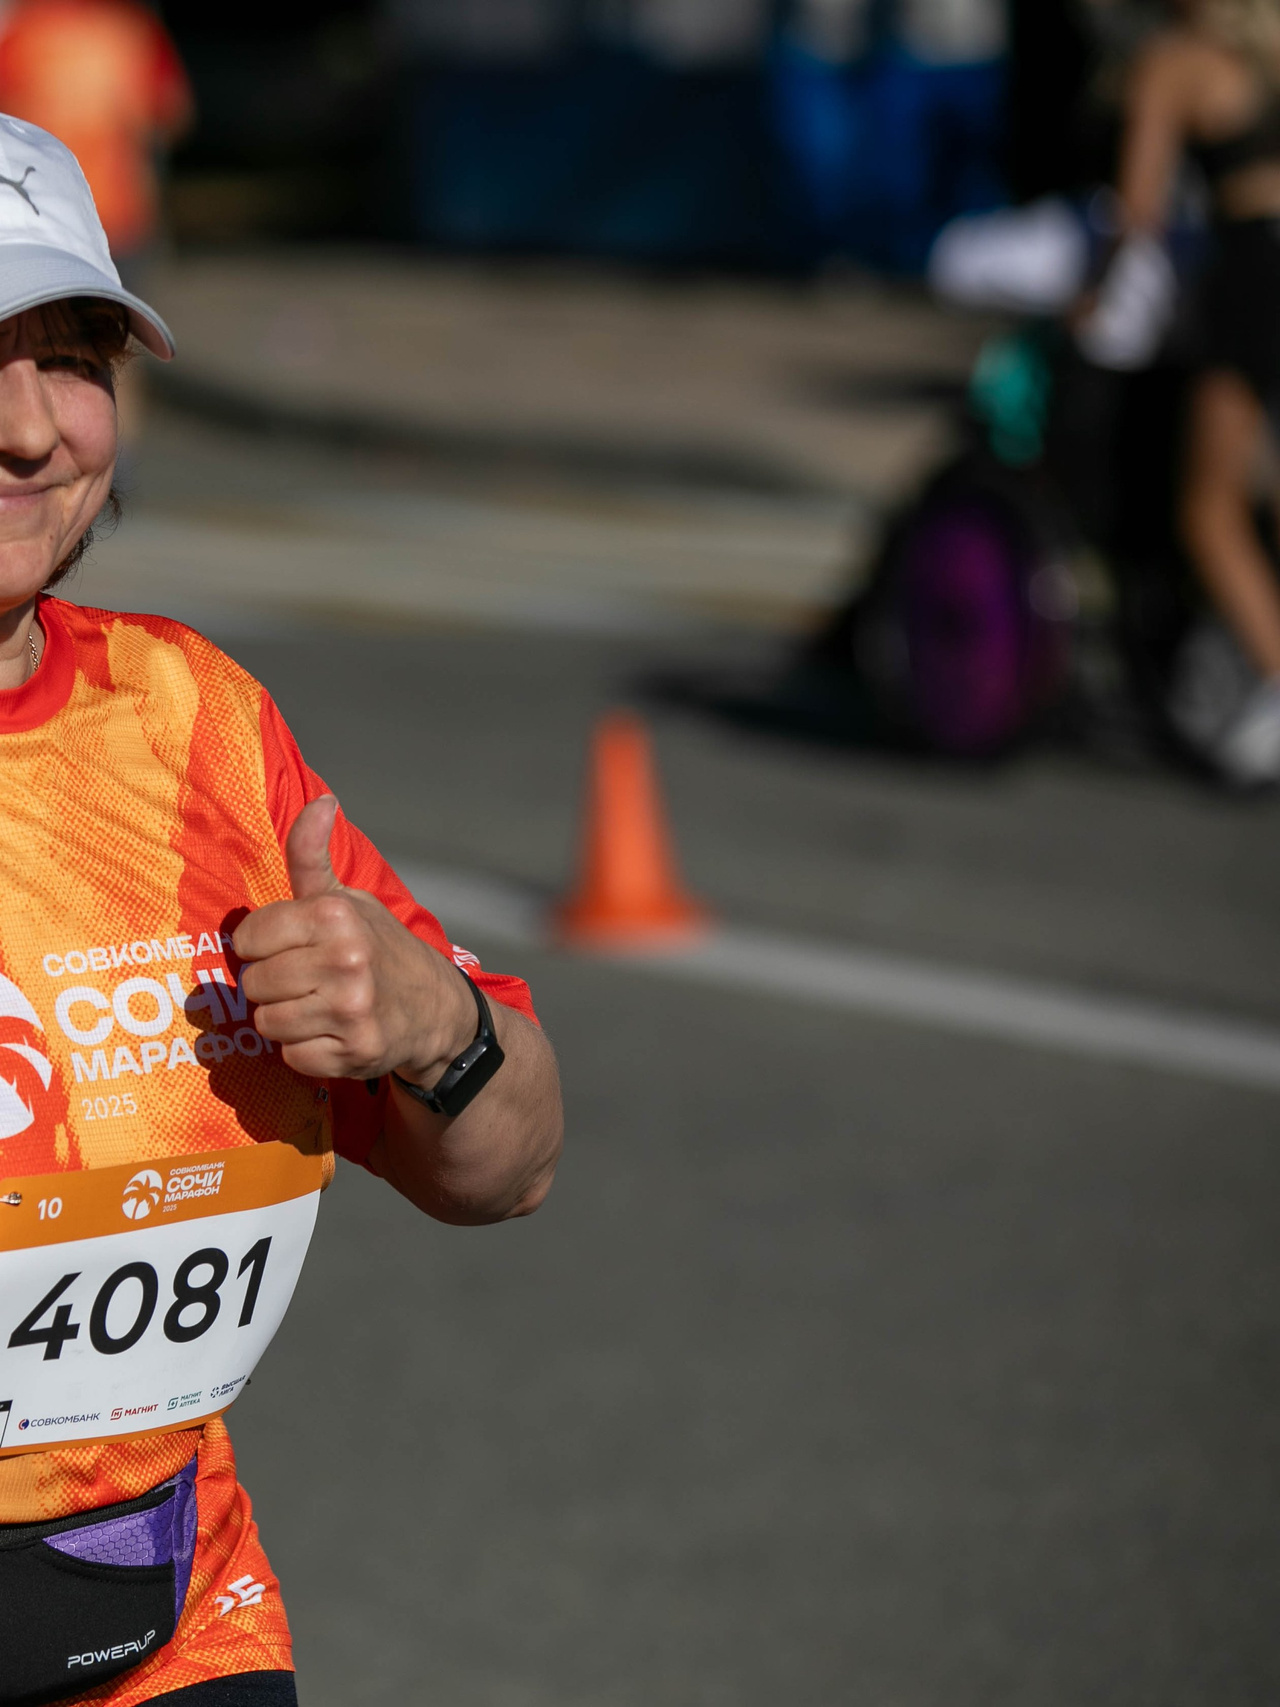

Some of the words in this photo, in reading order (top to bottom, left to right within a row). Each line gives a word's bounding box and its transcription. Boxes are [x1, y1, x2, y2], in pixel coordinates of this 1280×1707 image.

[43, 931, 235, 977] СОВКОМБАН
[71, 1027, 274, 1083] МАРАФО
[81, 1093, 137, 1121] 2025
[170, 1161, 224, 1175] СОВКОМБАНК
[166, 1170, 224, 1193] СОЧИ
[164, 1186, 219, 1203] МАРАФОН
[38, 1197, 63, 1220] 10
[162, 1204, 177, 1212] 2025
[7, 1236, 273, 1361] 4081
[179, 1398, 200, 1407] АПТЕКА
[180, 1391, 202, 1400] МАГНИТ
[30, 1412, 100, 1427] СОВКОМБАНК
[124, 1404, 159, 1416] МАГНИТ
[67, 1629, 156, 1669] POWERUP
